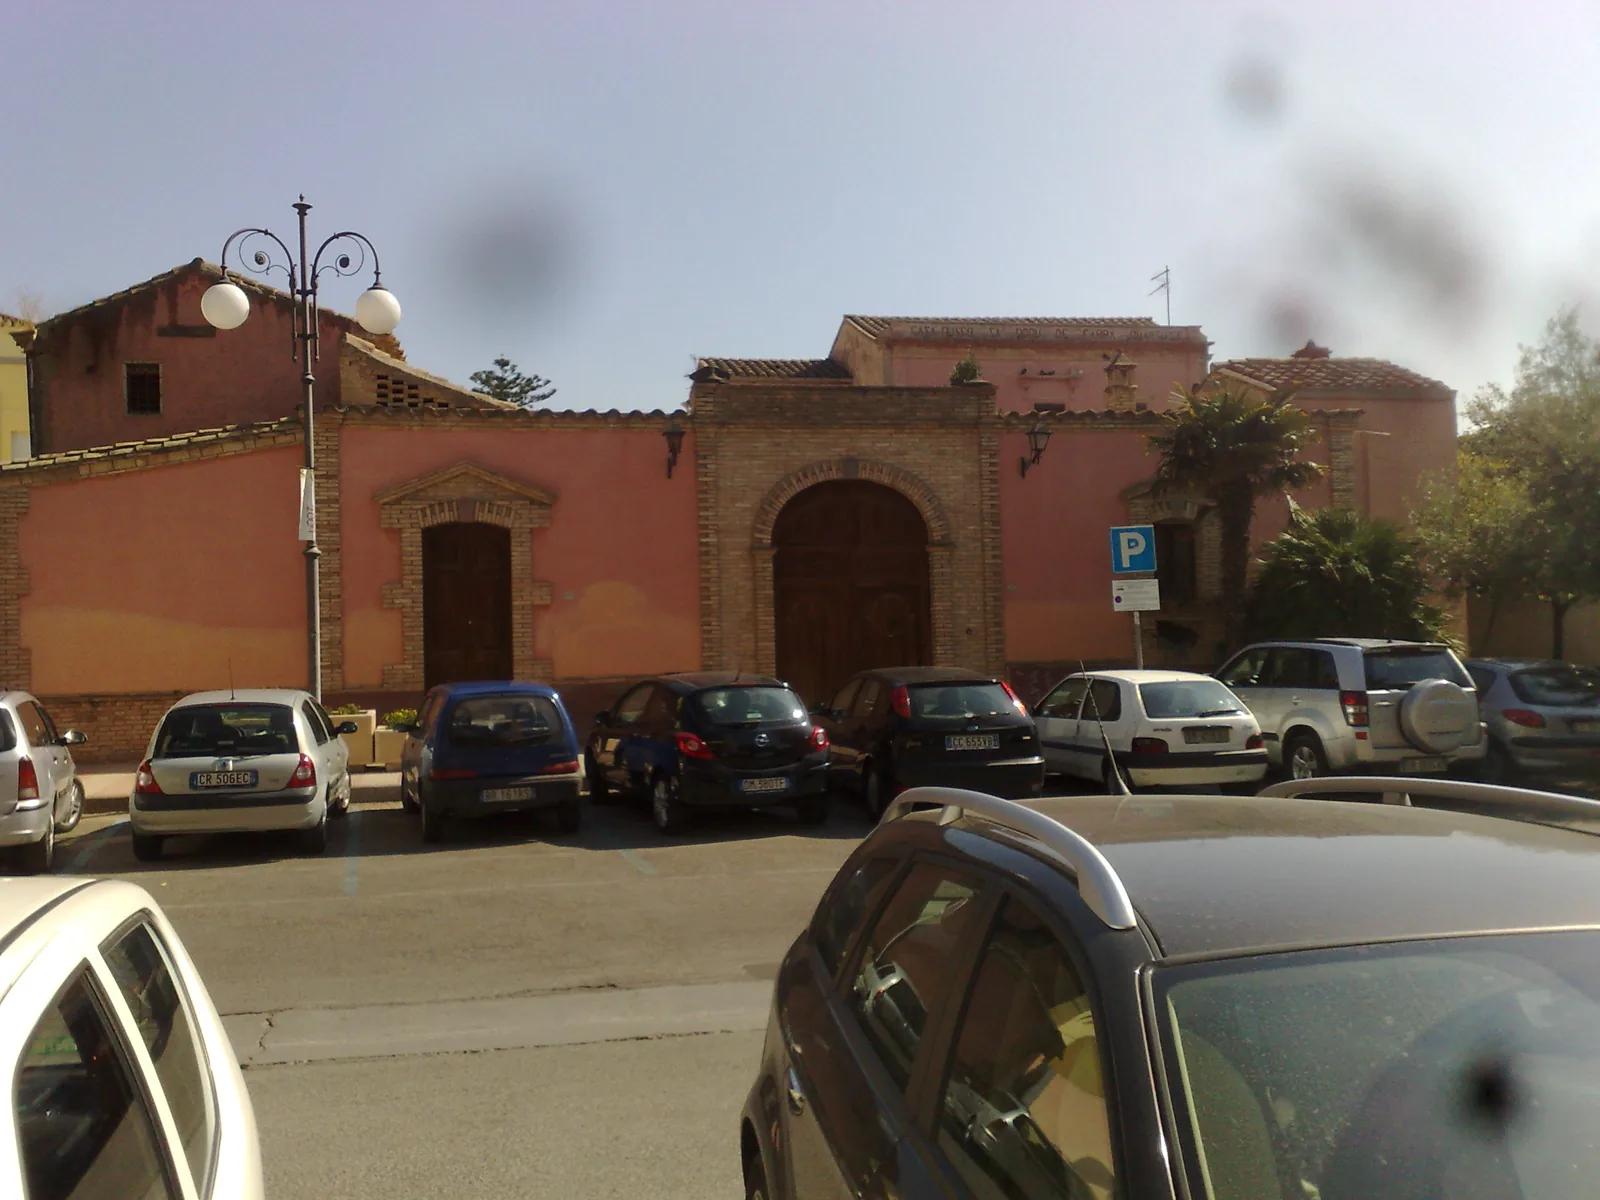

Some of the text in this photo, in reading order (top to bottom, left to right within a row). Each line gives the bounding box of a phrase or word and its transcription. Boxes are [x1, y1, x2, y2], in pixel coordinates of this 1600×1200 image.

[1120, 532, 1146, 568] P
[199, 773, 249, 785] CR 506EC
